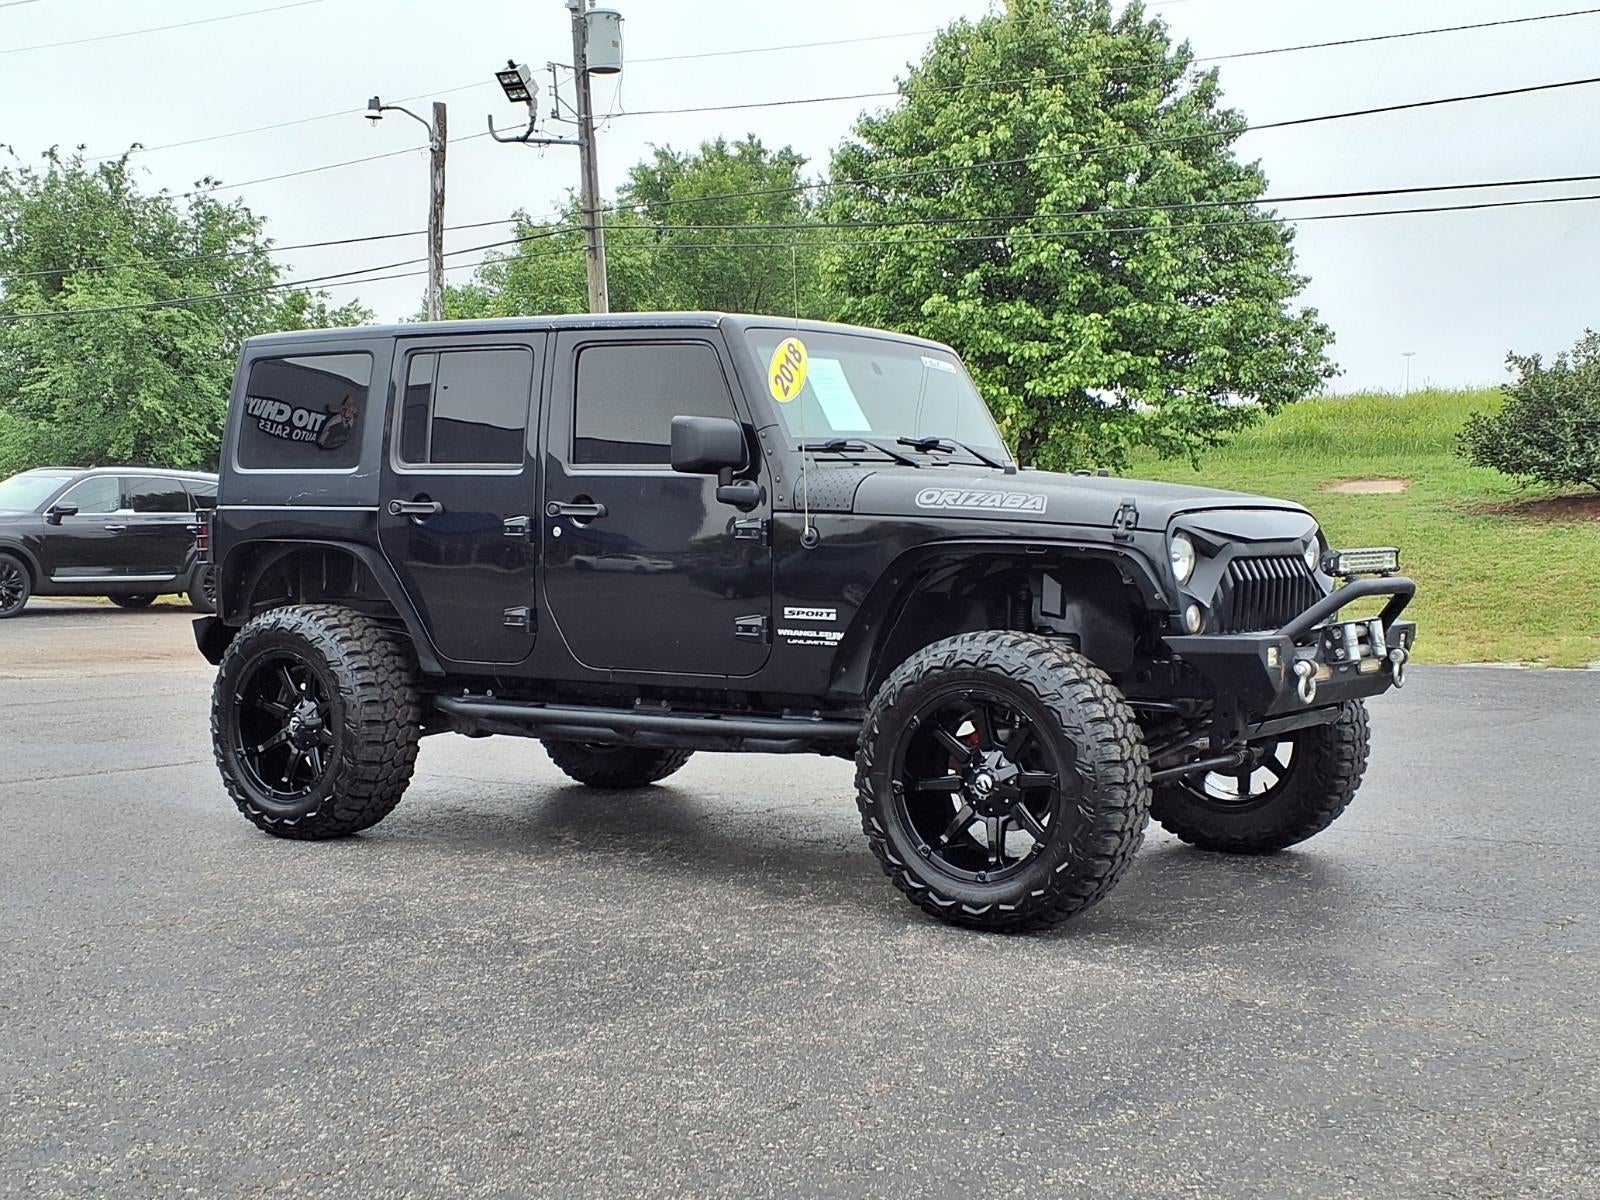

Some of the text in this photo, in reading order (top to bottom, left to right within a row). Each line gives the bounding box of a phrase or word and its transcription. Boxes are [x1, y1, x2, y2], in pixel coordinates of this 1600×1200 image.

[774, 342, 803, 397] 2018
[917, 488, 1045, 511] ORIZABA
[786, 609, 833, 617] SPORT
